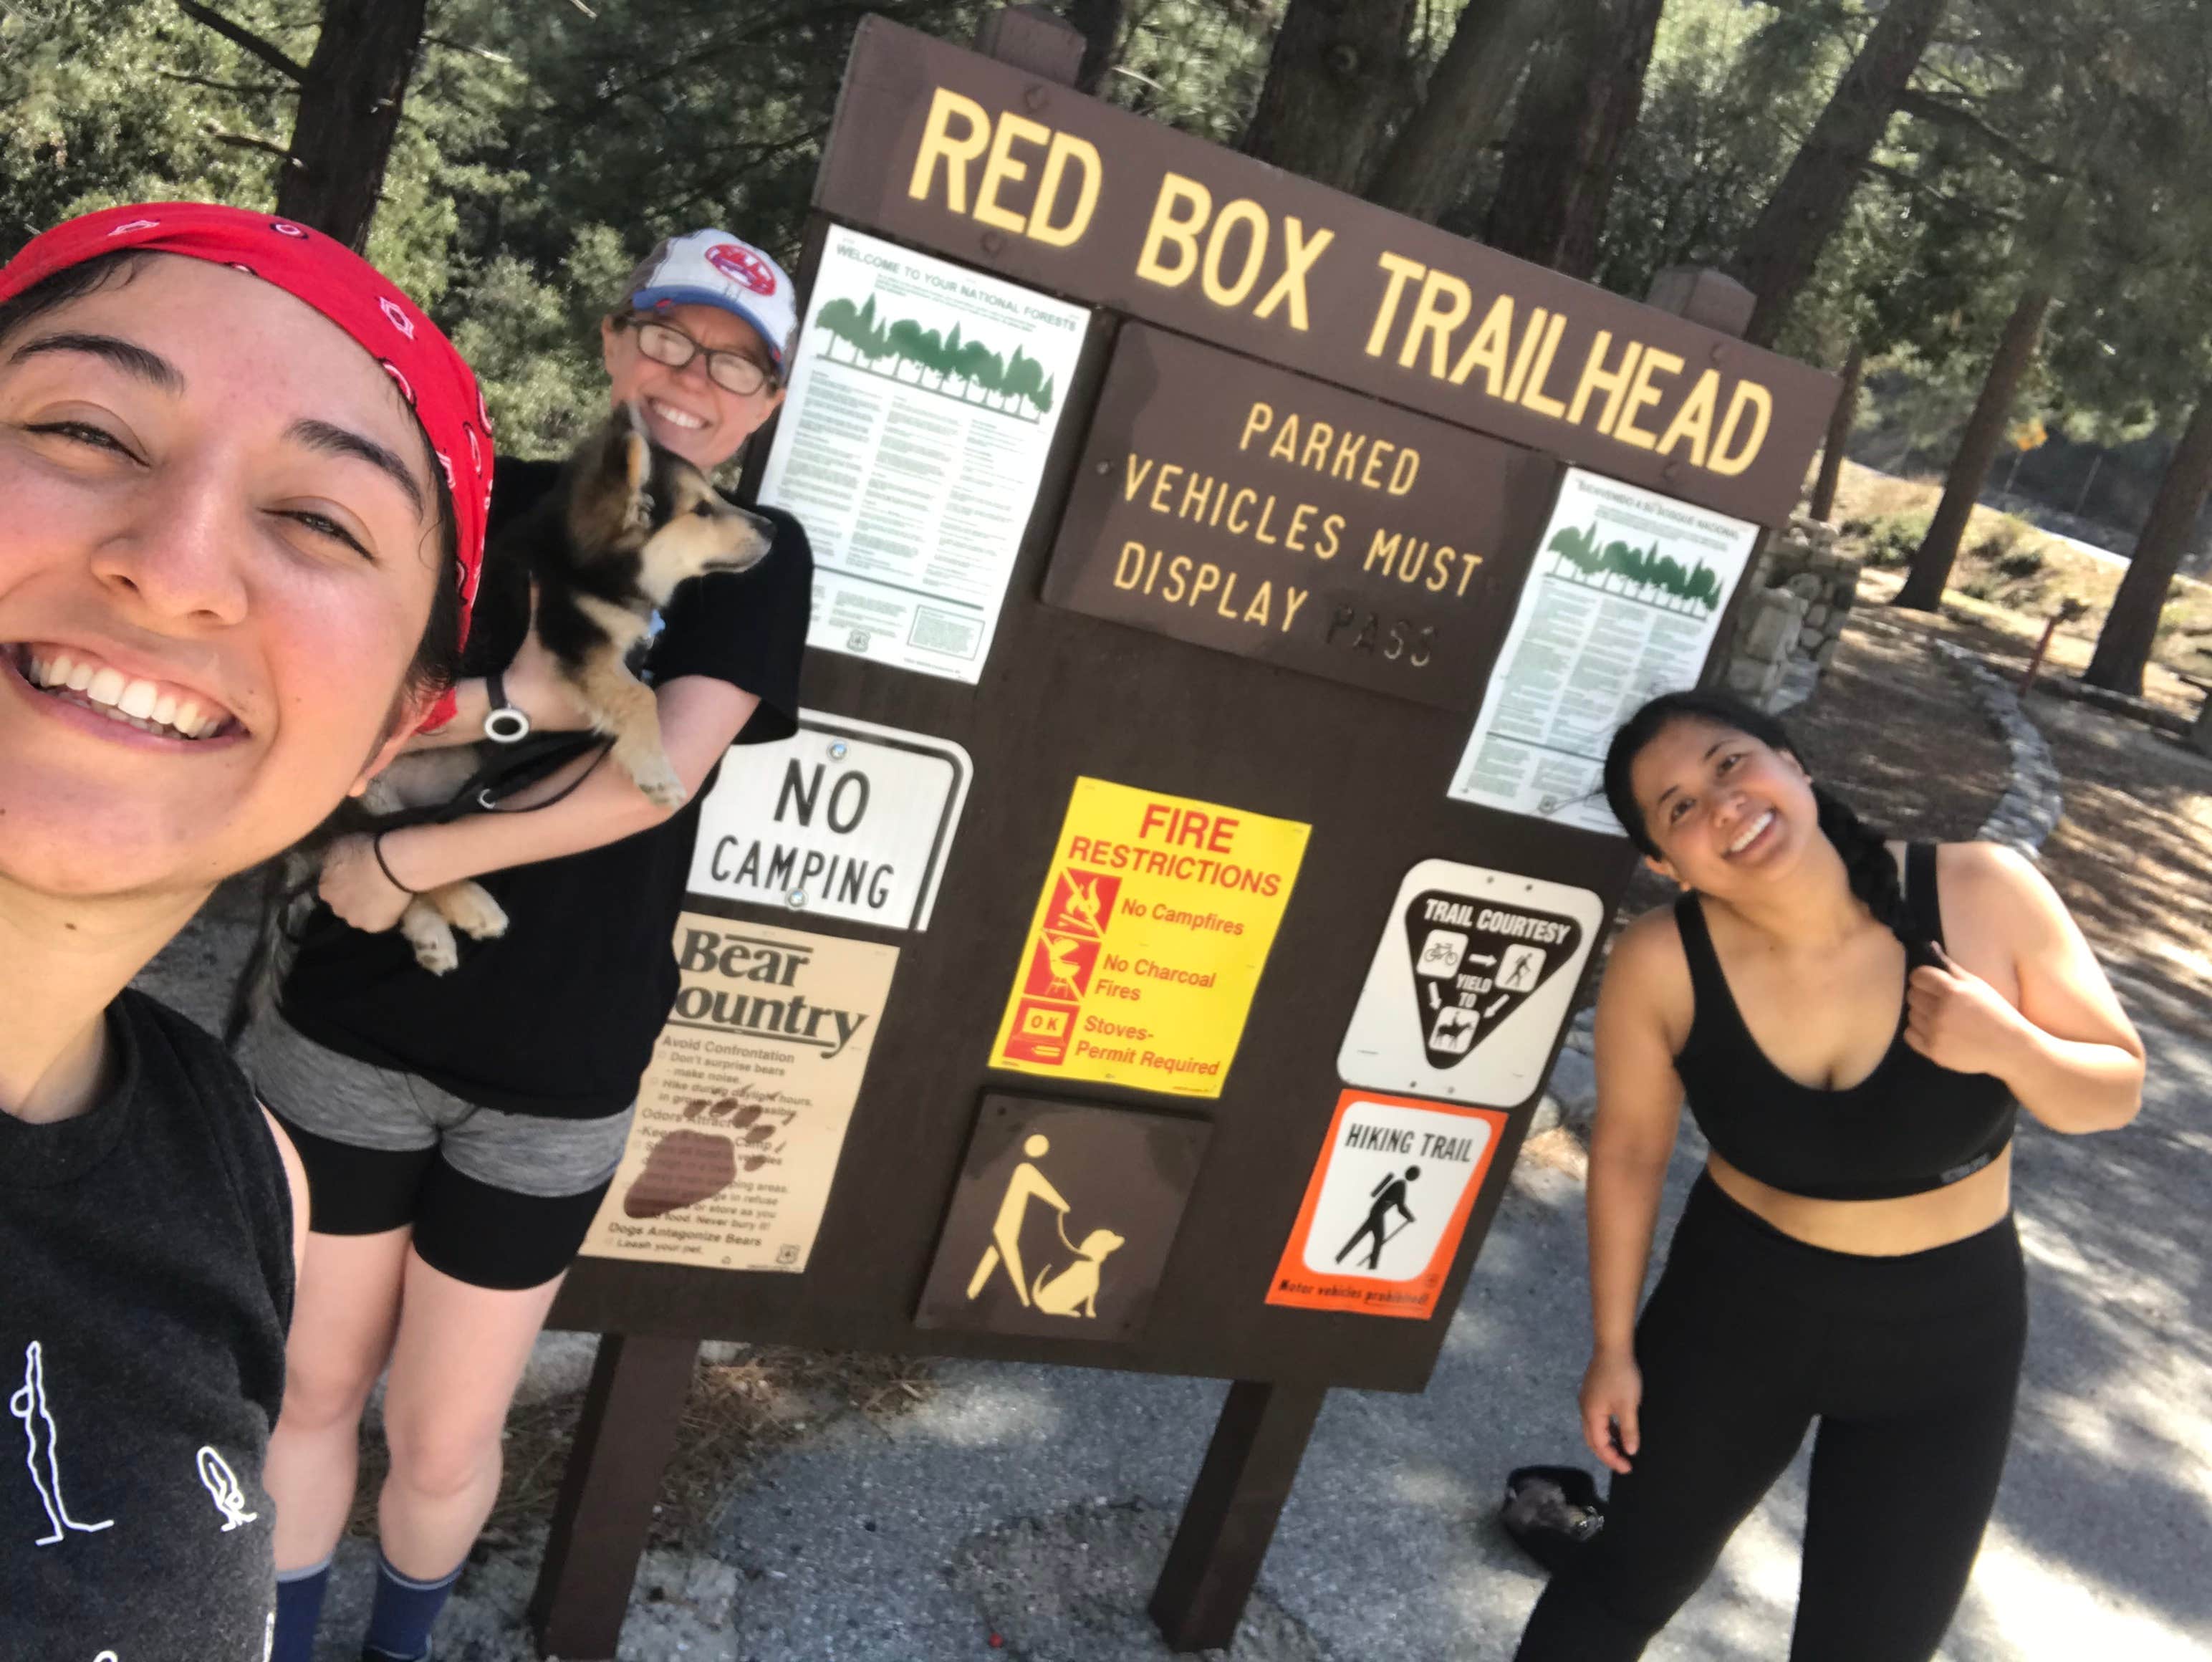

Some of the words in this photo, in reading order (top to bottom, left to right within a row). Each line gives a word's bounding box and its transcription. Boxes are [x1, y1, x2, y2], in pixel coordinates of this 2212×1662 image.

[836, 243, 900, 274] WELCOME
[905, 266, 922, 280] TO
[924, 271, 958, 292] YOUR
[960, 284, 1020, 314] NATIONAL
[1022, 306, 1077, 332] FORESTS
[908, 87, 1103, 247] RED
[1136, 171, 1335, 332] BOX
[1365, 250, 1773, 476] TRAILHEAD
[1239, 403, 1420, 496] PARKED
[1125, 453, 1346, 559] VEHICLES
[1363, 529, 1483, 597] MUST
[1112, 541, 1309, 632] DISPLAY
[1327, 603, 1438, 667] PASS
[774, 756, 870, 835] NO
[1139, 802, 1239, 854] FIRE
[710, 834, 895, 910] CAMPING
[1067, 835, 1282, 898] RESTRICTIONS
[1121, 898, 1146, 917] No
[1150, 903, 1244, 936] Campfires
[1423, 898, 1474, 928] TRAIL
[1476, 908, 1572, 946] COURTESY
[679, 927, 811, 987] Bear
[1102, 954, 1129, 973] No
[1133, 959, 1217, 989] Charcoal
[1095, 978, 1142, 1001] Fires
[1455, 973, 1493, 994] YIELD
[1458, 992, 1478, 1009] TO
[675, 986, 869, 1060] ountry
[1084, 1014, 1154, 1041] Stoves-
[662, 1036, 701, 1051] Avoid
[705, 1041, 796, 1064] Confrontation
[705, 1057, 751, 1073] surprise
[1074, 1040, 1138, 1065] Permit
[1140, 1050, 1221, 1077] Required
[1345, 1123, 1415, 1155] HIKING
[1420, 1133, 1473, 1163] TRAIL
[609, 1221, 643, 1238] Dogs
[647, 1225, 722, 1243] Antagonize
[725, 1233, 762, 1246] Bears
